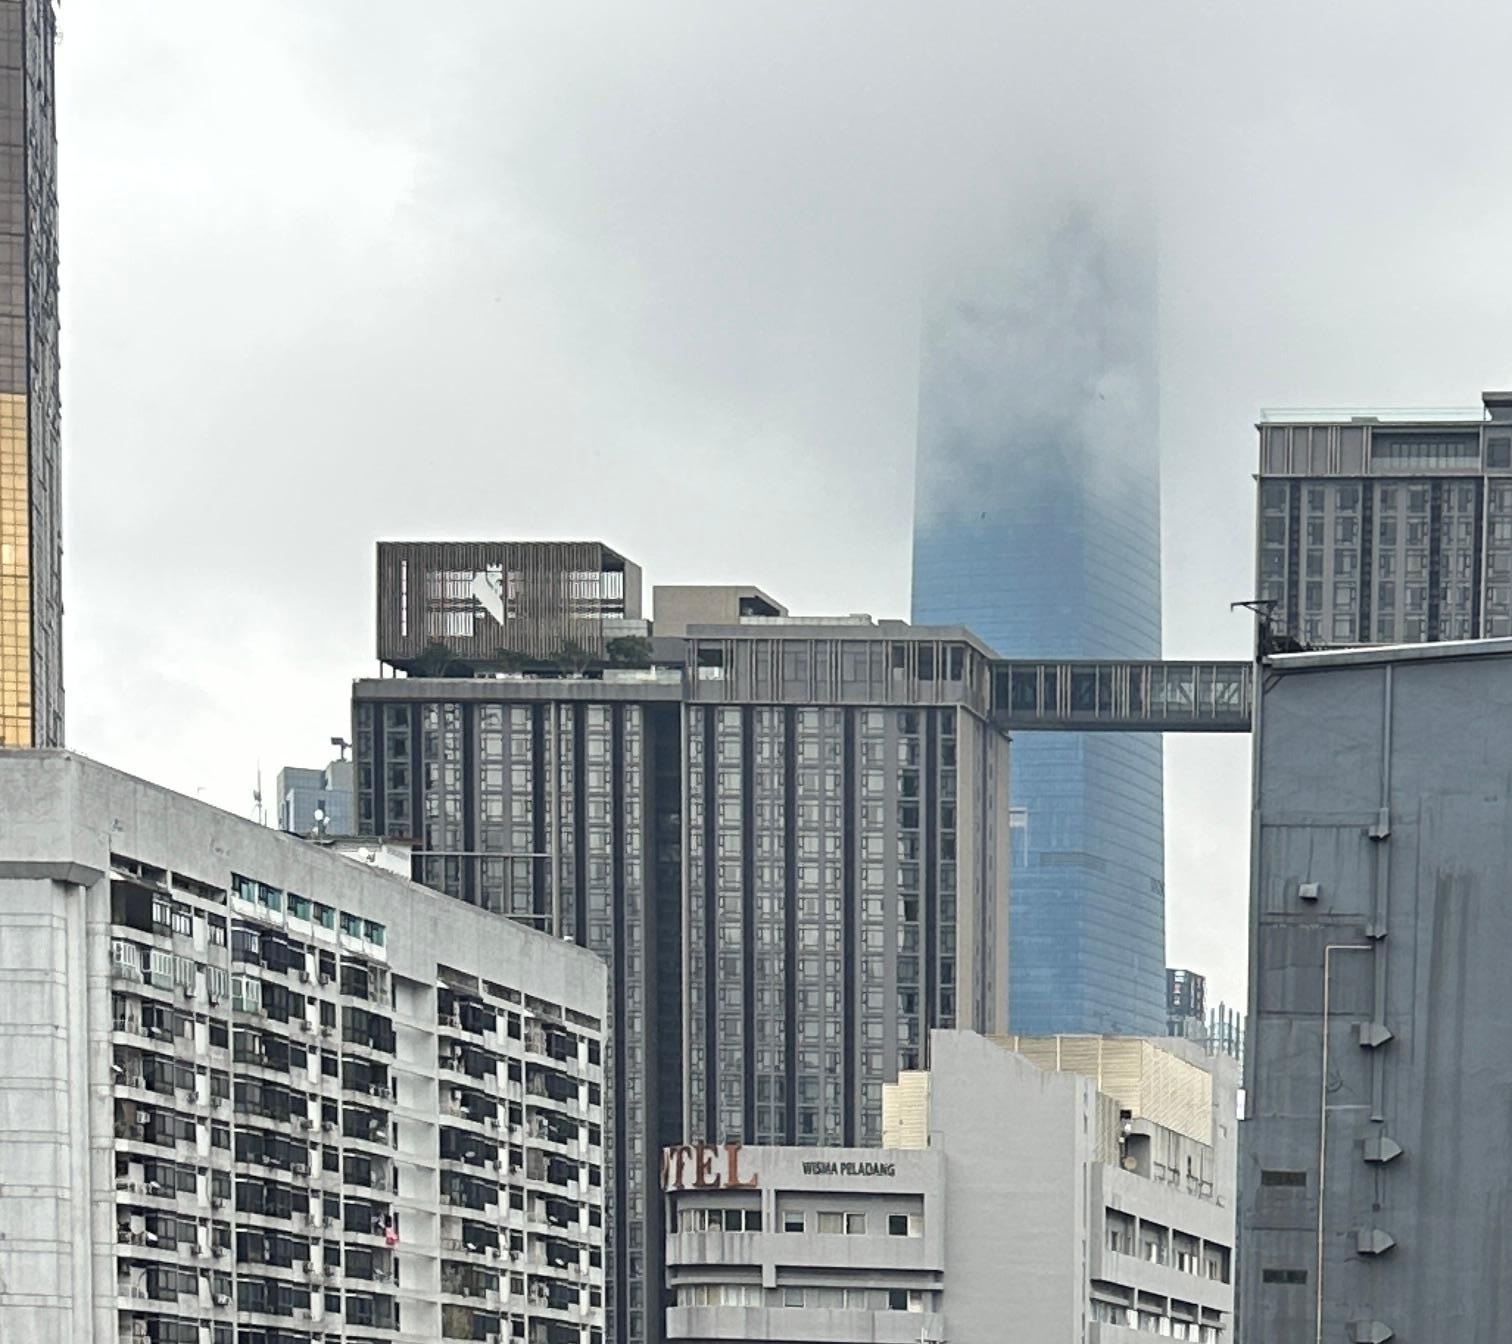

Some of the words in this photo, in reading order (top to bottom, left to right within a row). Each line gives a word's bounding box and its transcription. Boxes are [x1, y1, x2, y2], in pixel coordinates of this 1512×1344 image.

[661, 1143, 758, 1190] TEL
[802, 1160, 837, 1176] WISMA
[840, 1161, 895, 1177] PELADANG
